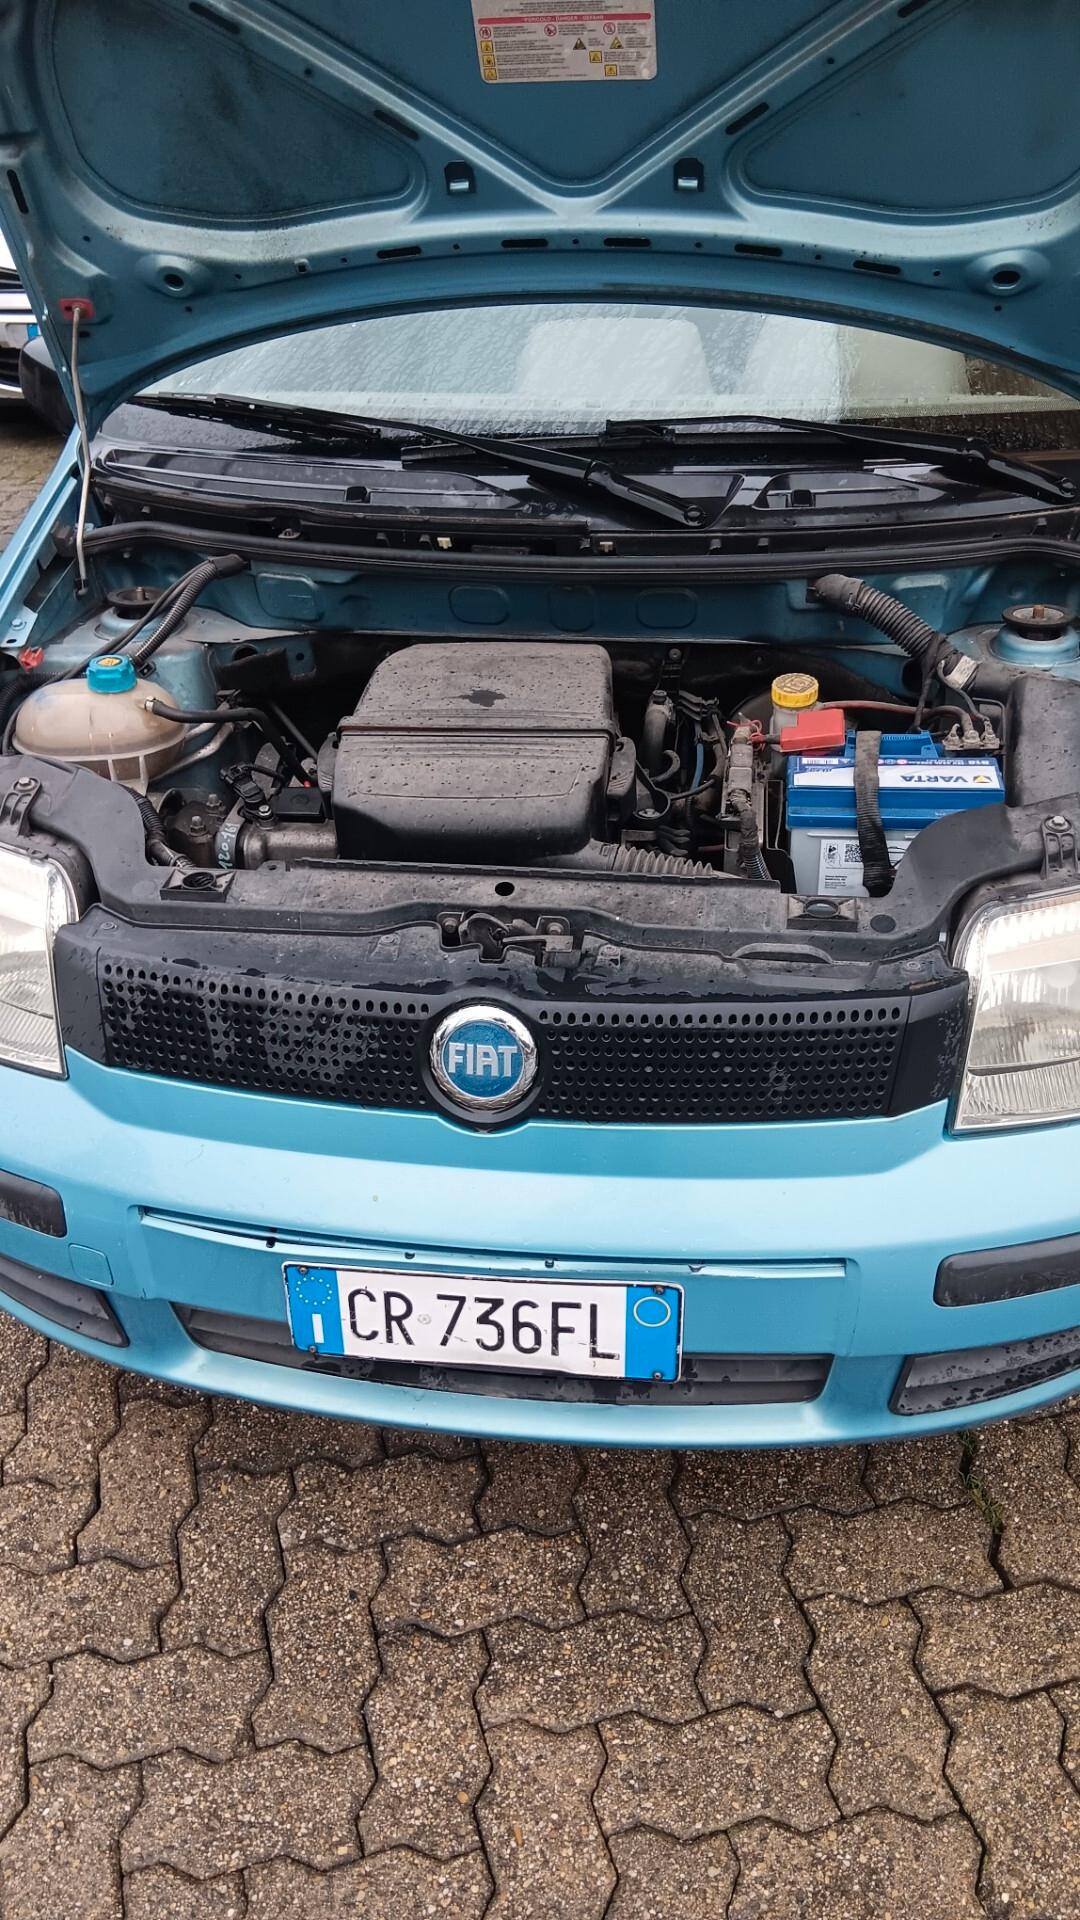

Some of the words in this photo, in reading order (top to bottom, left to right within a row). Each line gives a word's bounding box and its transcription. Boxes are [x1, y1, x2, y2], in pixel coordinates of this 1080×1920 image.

[900, 775, 969, 783] VARTA
[448, 1042, 518, 1077] FIAT
[347, 1287, 415, 1346] CR
[436, 1293, 621, 1361] 736FL
